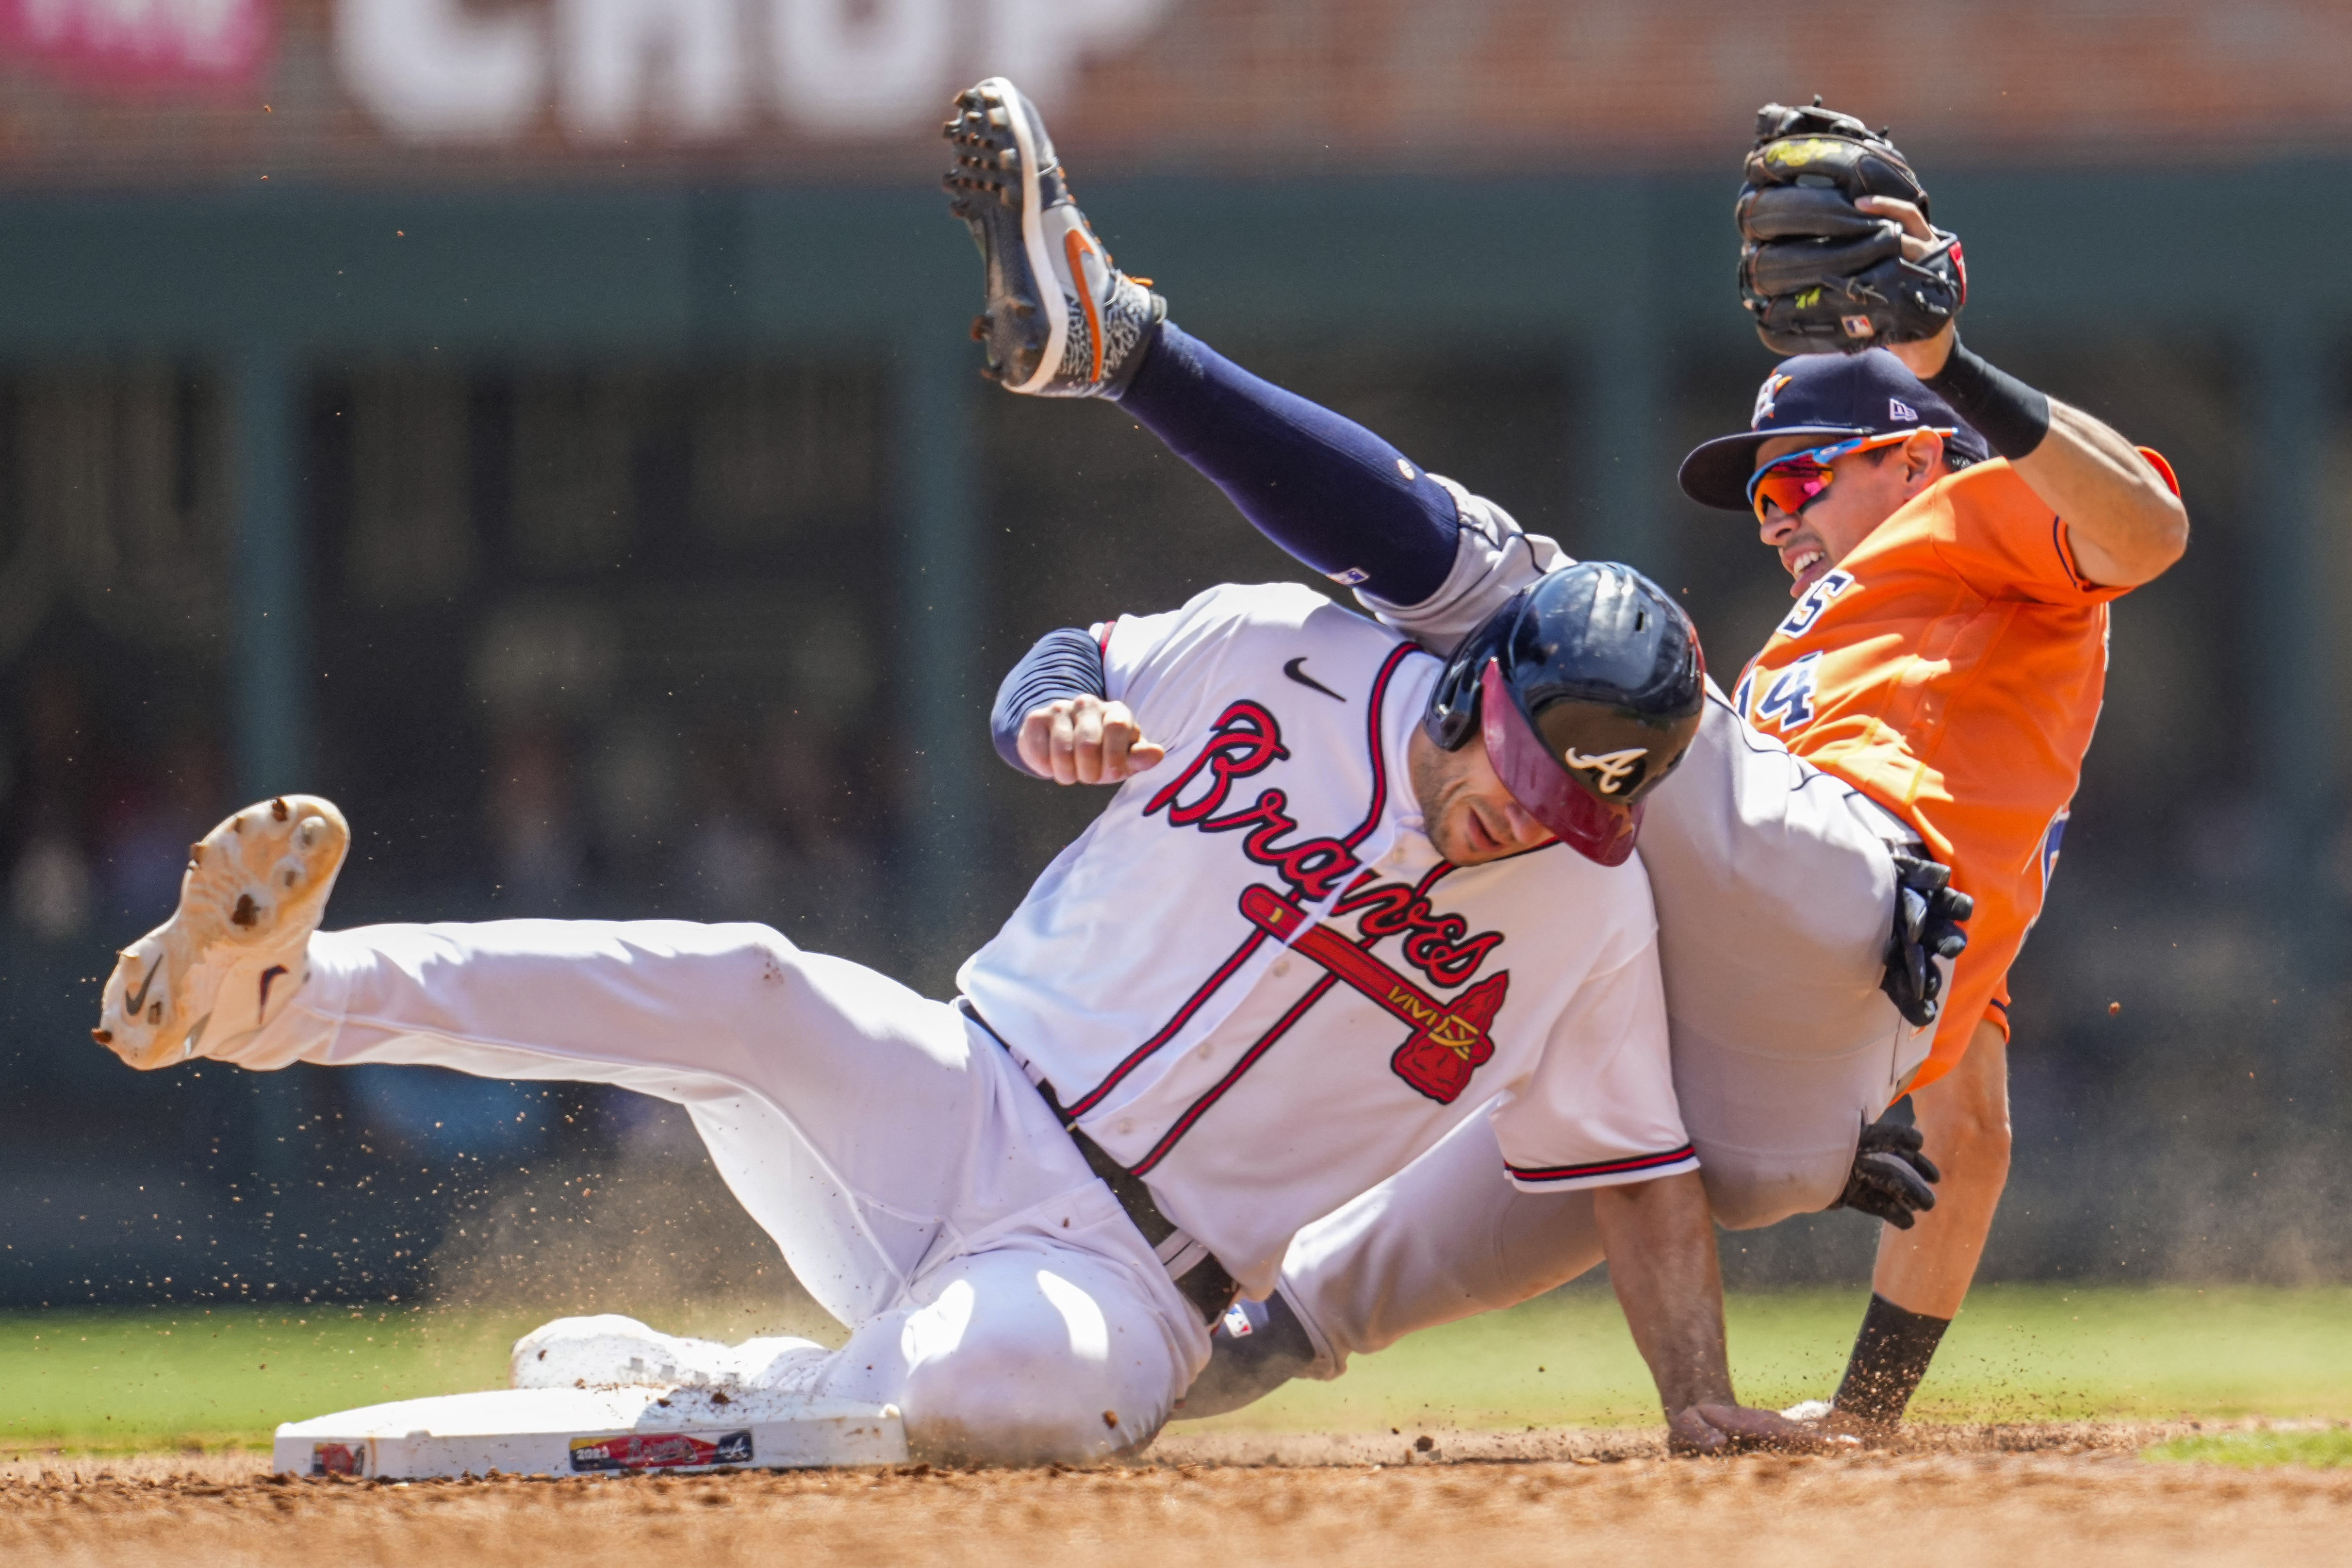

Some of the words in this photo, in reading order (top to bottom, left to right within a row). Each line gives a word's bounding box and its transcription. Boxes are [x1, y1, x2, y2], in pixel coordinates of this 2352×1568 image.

[1734, 650, 1824, 732] 14
[1565, 747, 1649, 793] A
[1142, 699, 1505, 988] Braves
